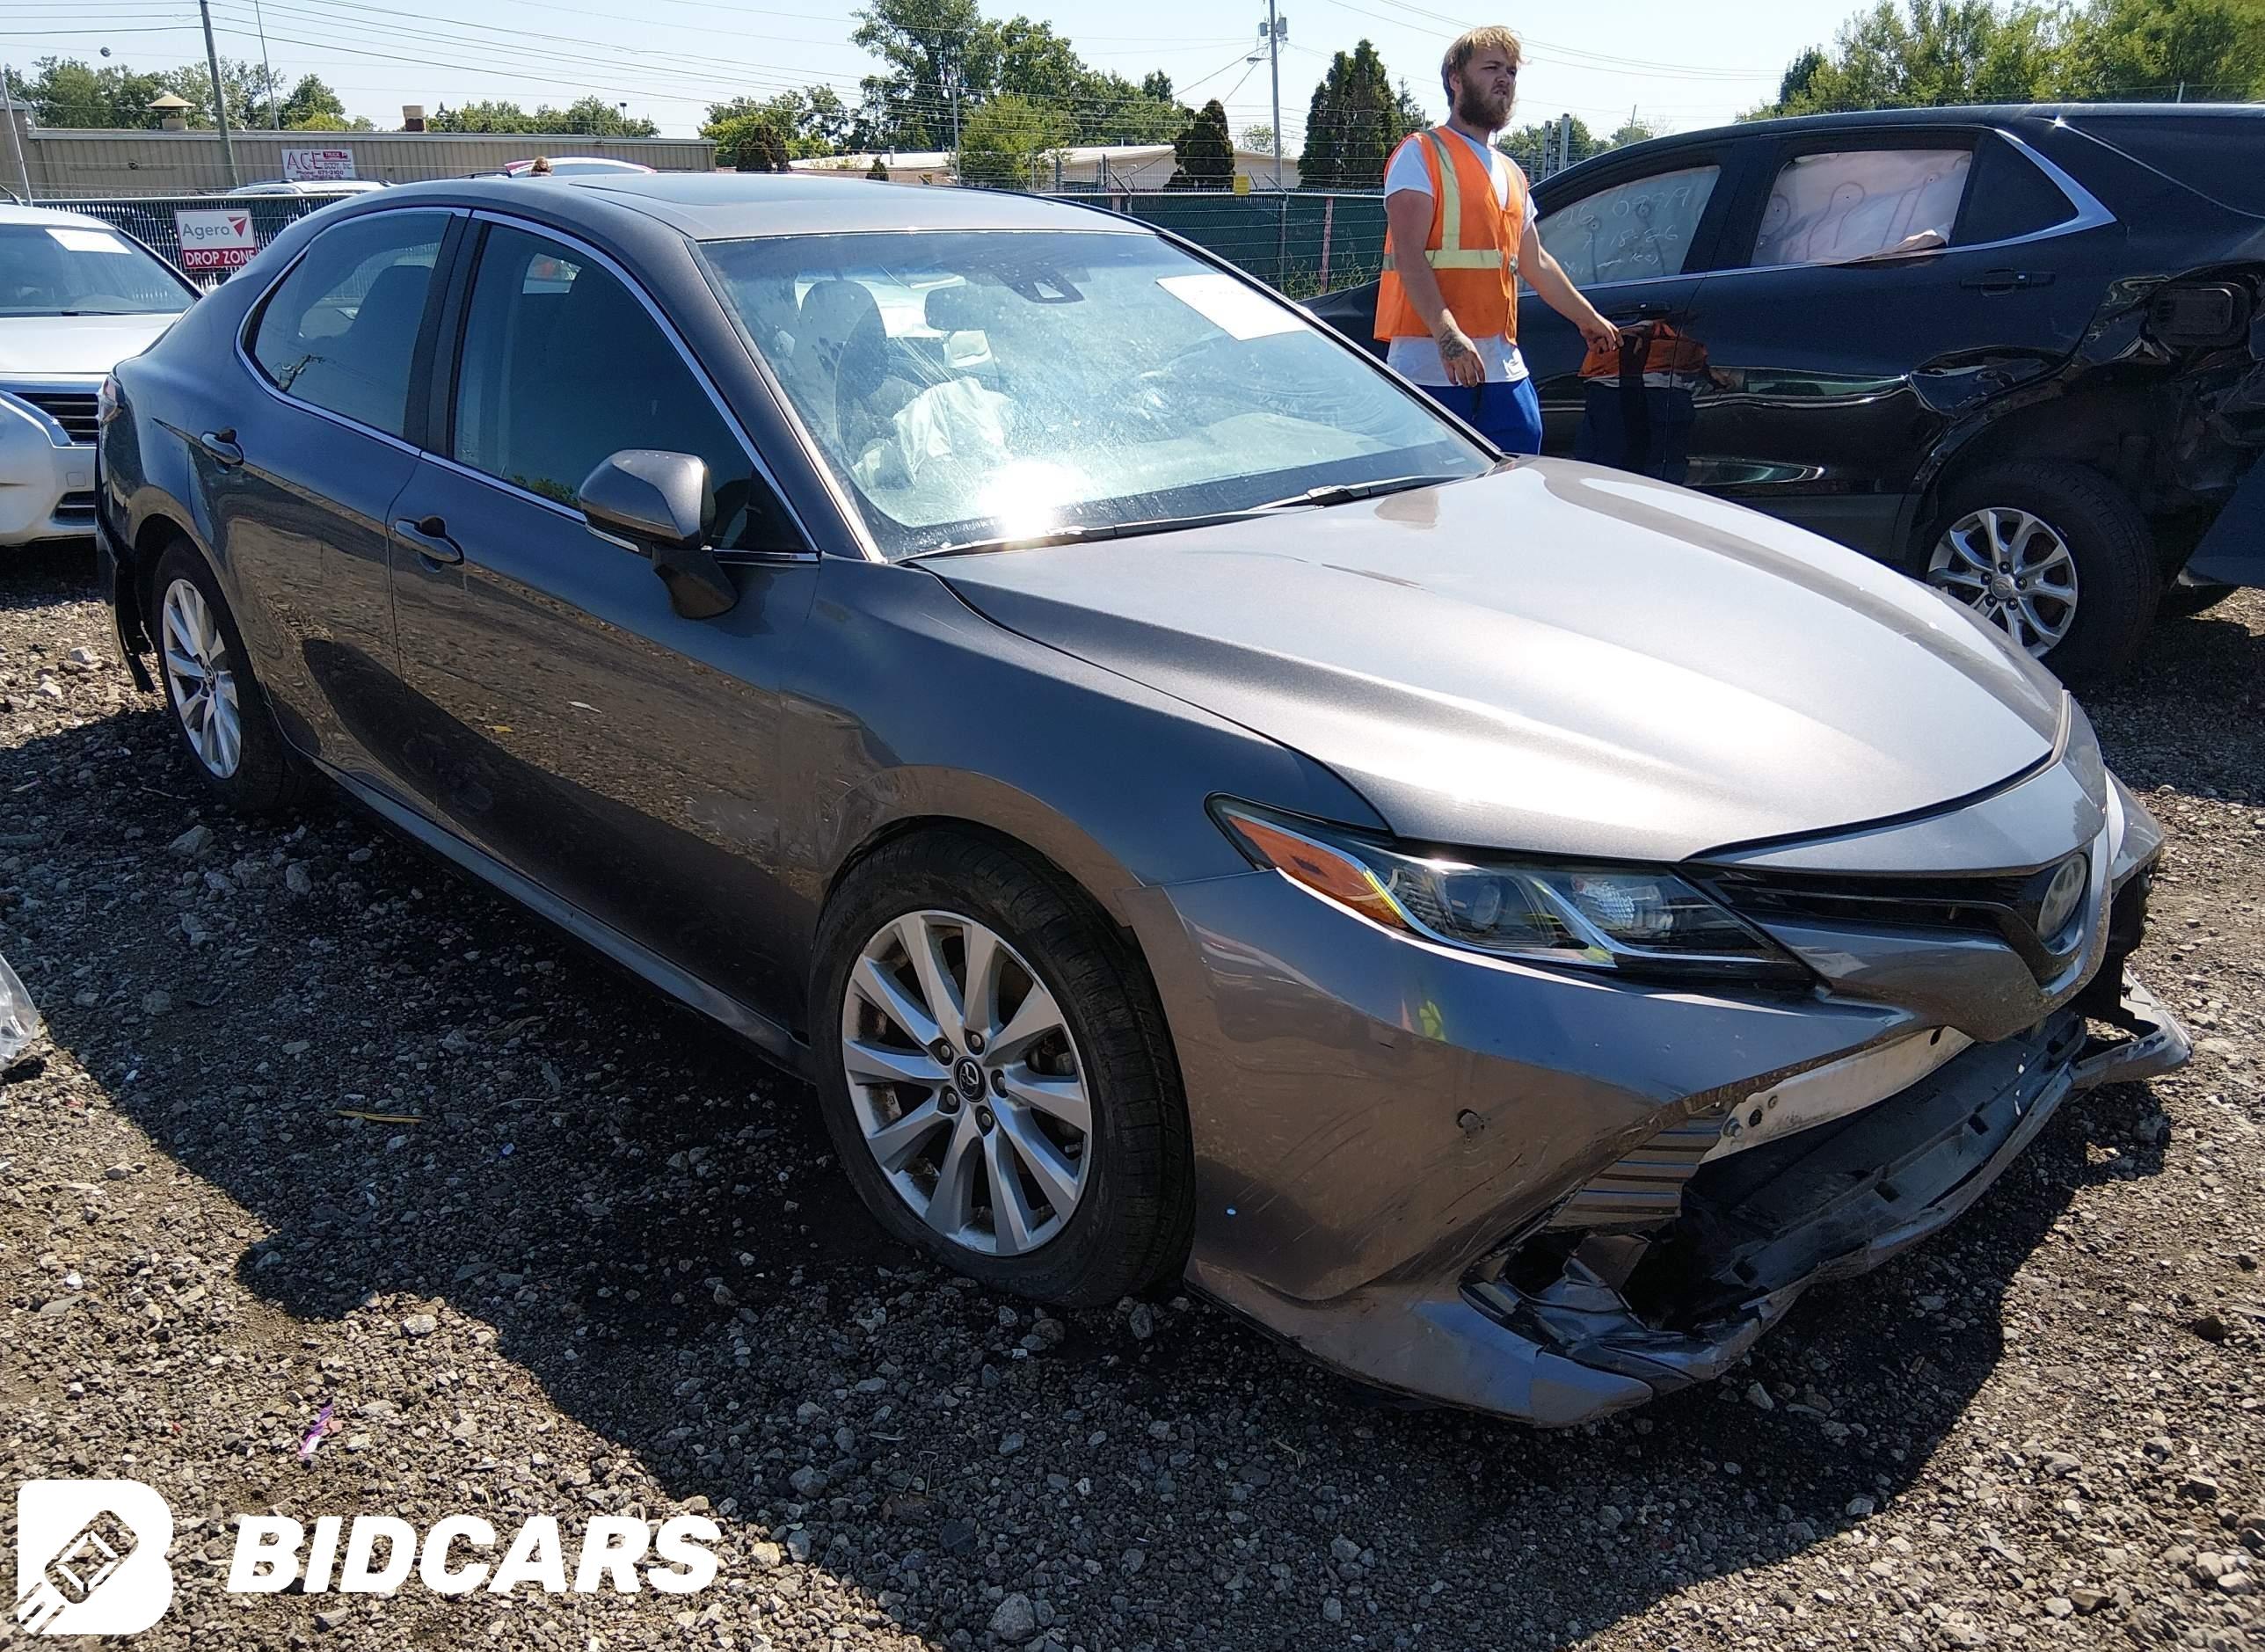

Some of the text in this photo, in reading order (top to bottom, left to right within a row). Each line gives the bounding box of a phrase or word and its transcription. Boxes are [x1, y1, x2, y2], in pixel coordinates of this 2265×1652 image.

[287, 151, 323, 170] ACE
[182, 222, 229, 240] Agero
[185, 251, 220, 266] DROP
